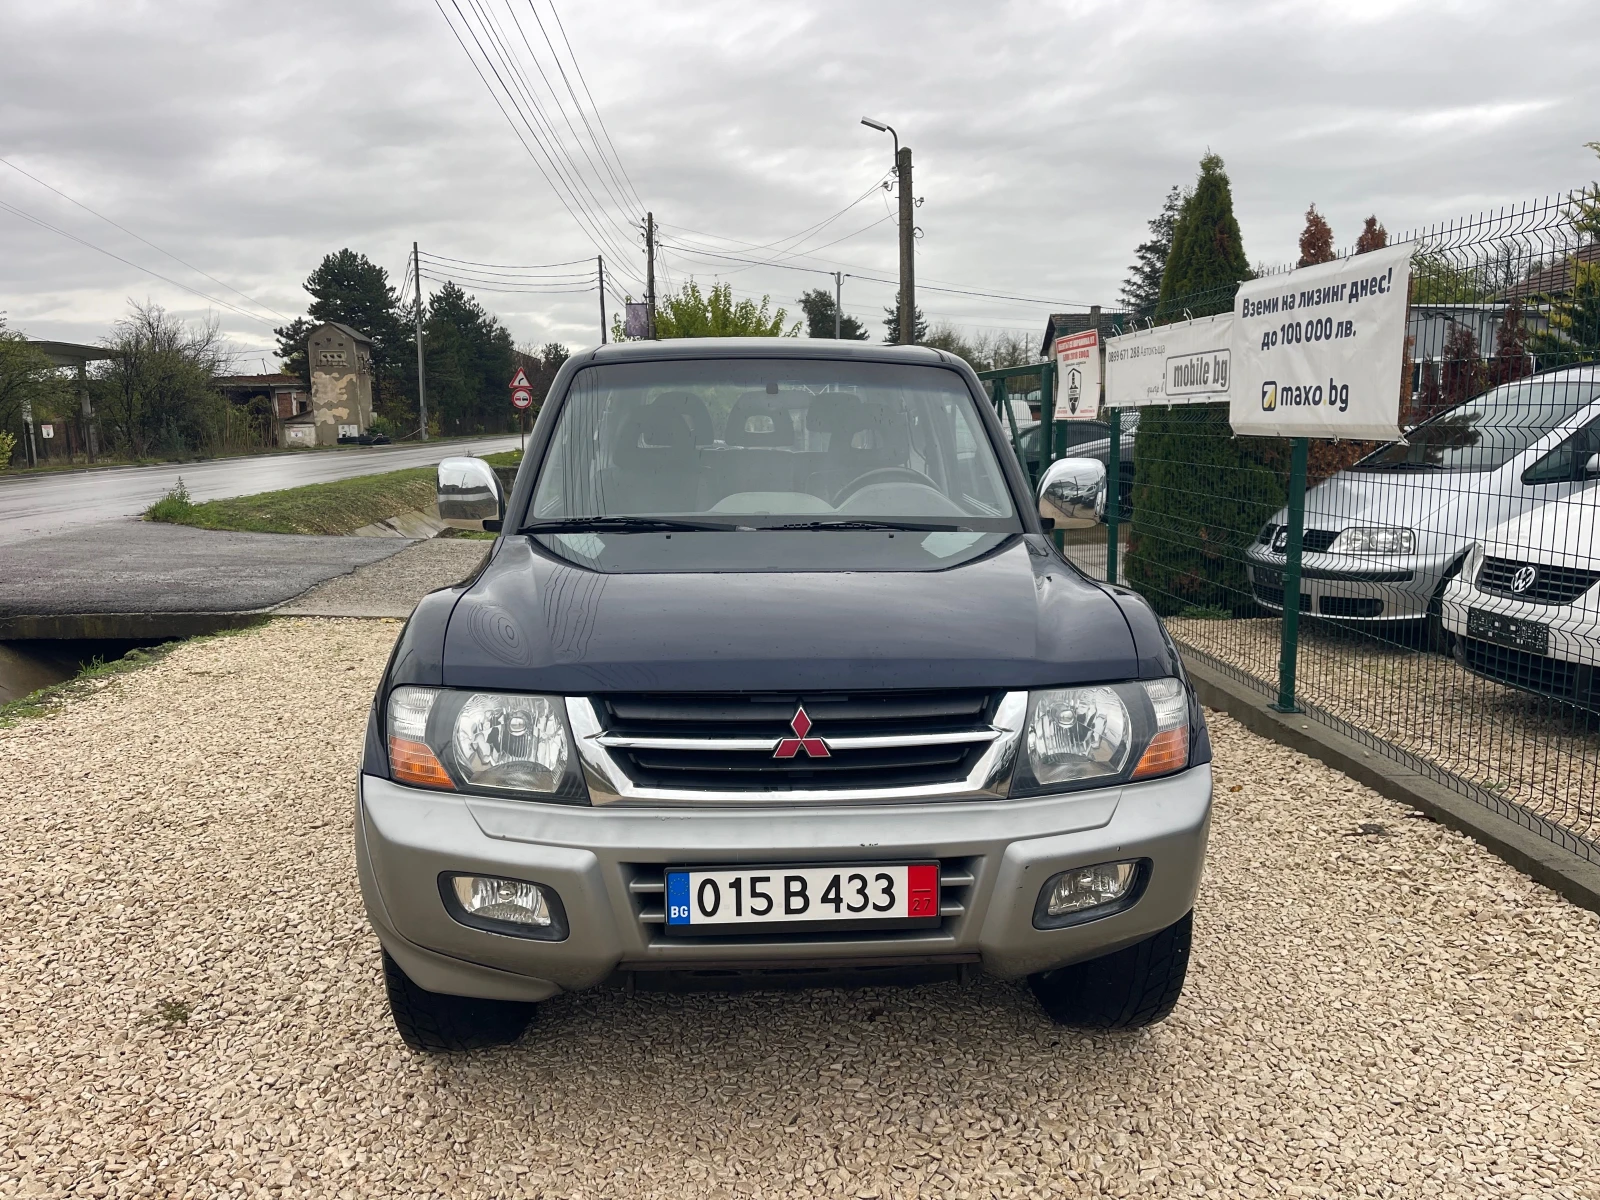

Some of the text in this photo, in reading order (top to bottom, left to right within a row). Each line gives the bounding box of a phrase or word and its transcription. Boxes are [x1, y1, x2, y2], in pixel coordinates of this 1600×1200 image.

[1242, 267, 1393, 318] Вземи на лизинг днес!
[1261, 317, 1357, 351] до 100 000 лв.
[1108, 350, 1119, 363] 0899
[1120, 348, 1129, 360] 671
[1130, 346, 1140, 359] 288
[1173, 356, 1210, 388] mobile
[1280, 377, 1349, 413] maxo.bg
[820, 873, 896, 913] 433
[912, 897, 931, 912] 27
[670, 905, 689, 919] BG
